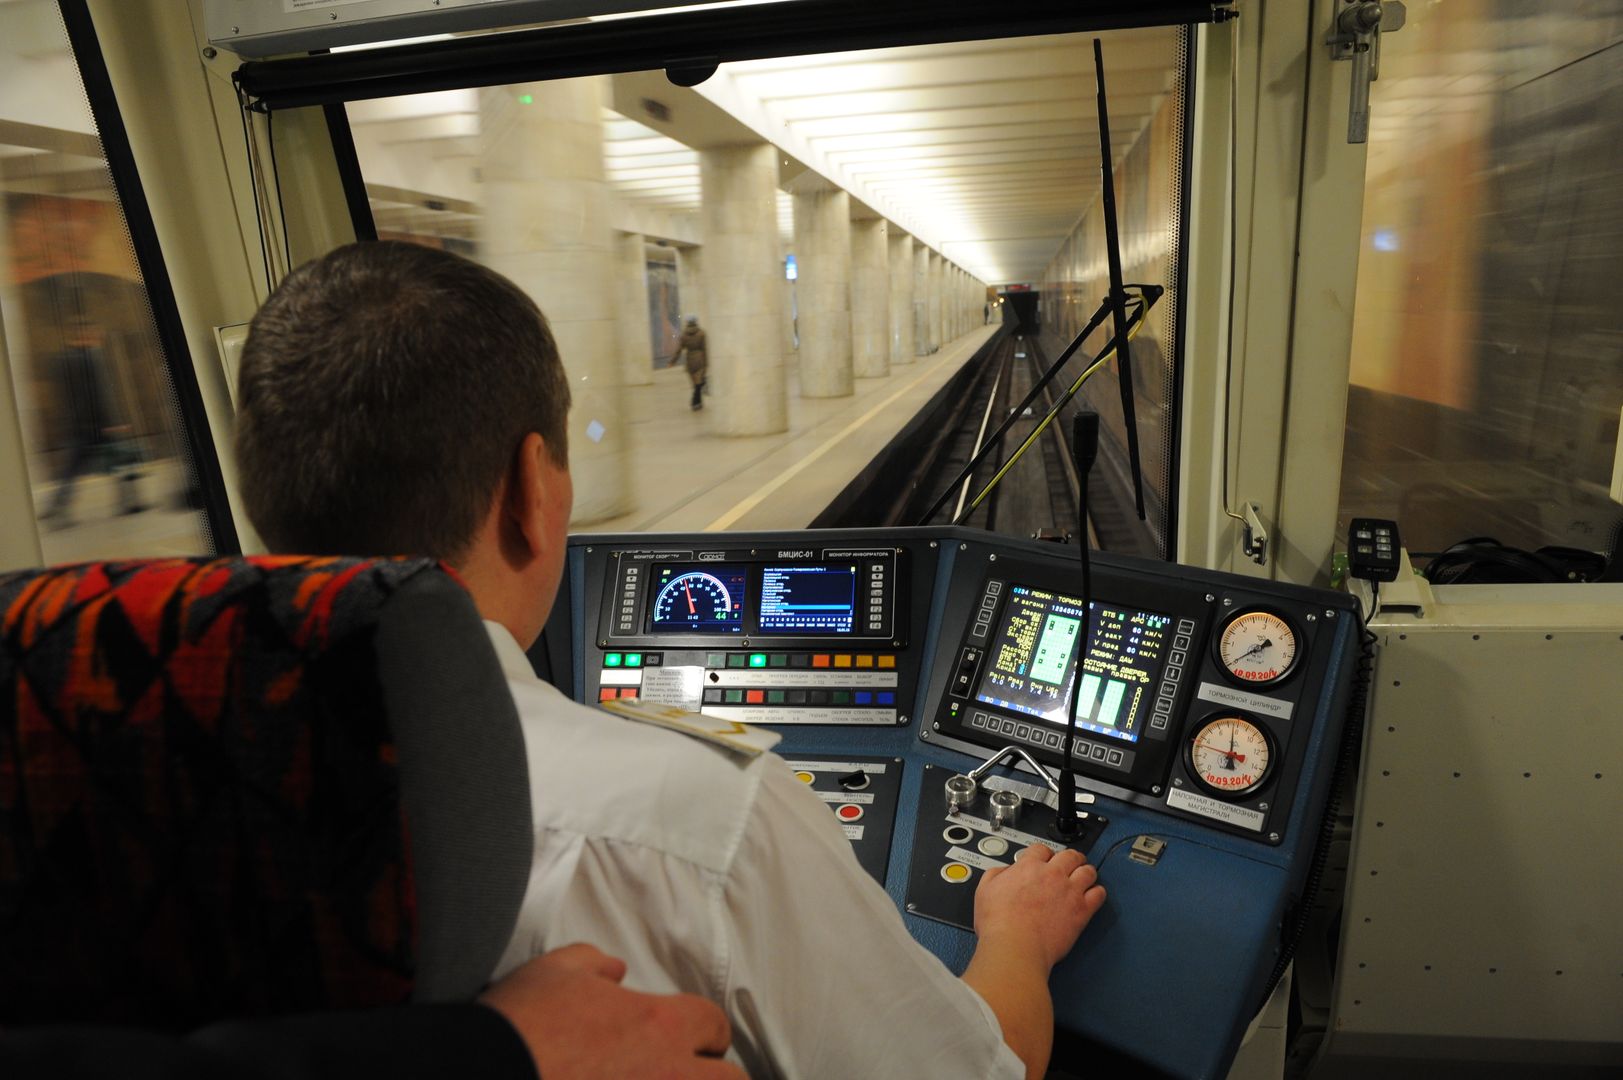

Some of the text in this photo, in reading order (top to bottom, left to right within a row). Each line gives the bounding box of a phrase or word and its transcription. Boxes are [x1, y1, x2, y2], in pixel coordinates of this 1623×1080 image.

[778, 551, 814, 559] БМЦИС-01
[1058, 596, 1082, 605] ТОРМОЗ
[1051, 605, 1082, 615] 12345678
[715, 612, 727, 620] 44
[1136, 612, 1170, 623] 11:44:21
[1144, 630, 1162, 638] км/ч
[1141, 640, 1159, 648] км/ч
[1138, 650, 1156, 658] км/ч
[1083, 659, 1146, 677] ОСТОЯНИЕ ДВЕРЕЙ
[1208, 690, 1282, 711] ТОРМОЗНОЙ ЦИЛИНДР
[1172, 790, 1208, 805] НАПОРНАЯ
[1218, 803, 1259, 819] ТОРМОЗНАЯ
[1188, 802, 1230, 819] МАГИСТРАЛИ
